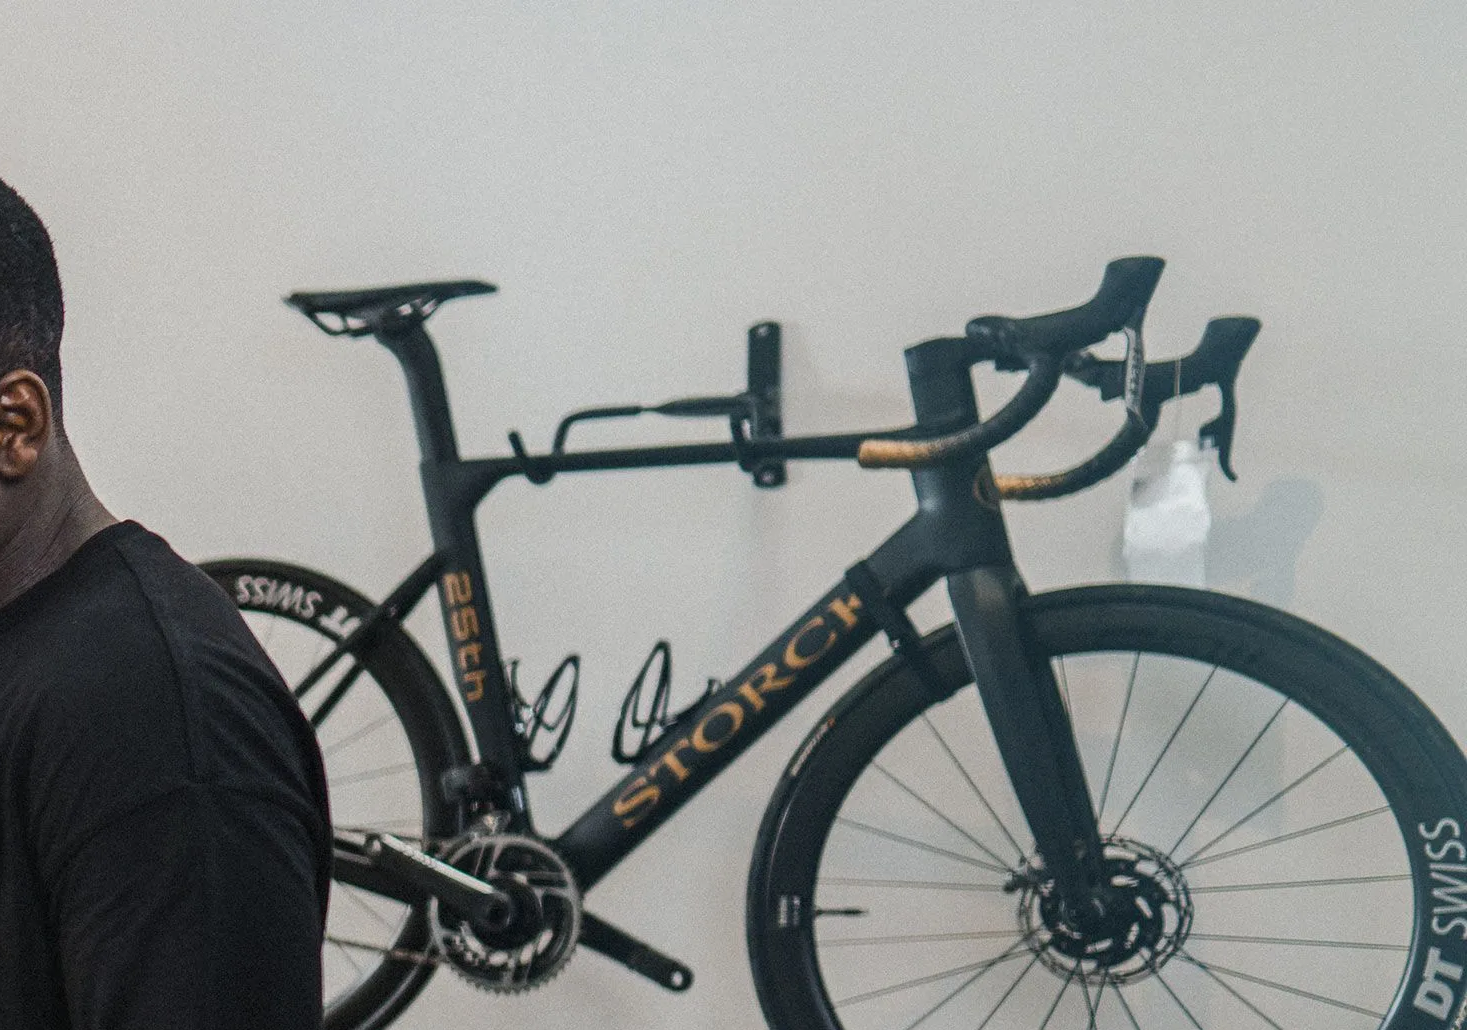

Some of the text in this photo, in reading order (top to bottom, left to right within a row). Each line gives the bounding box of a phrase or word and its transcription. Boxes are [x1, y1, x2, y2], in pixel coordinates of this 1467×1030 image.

[235, 574, 323, 619] SWISS
[441, 571, 485, 703] 25th
[1414, 816, 1467, 1021] DT SWISS
